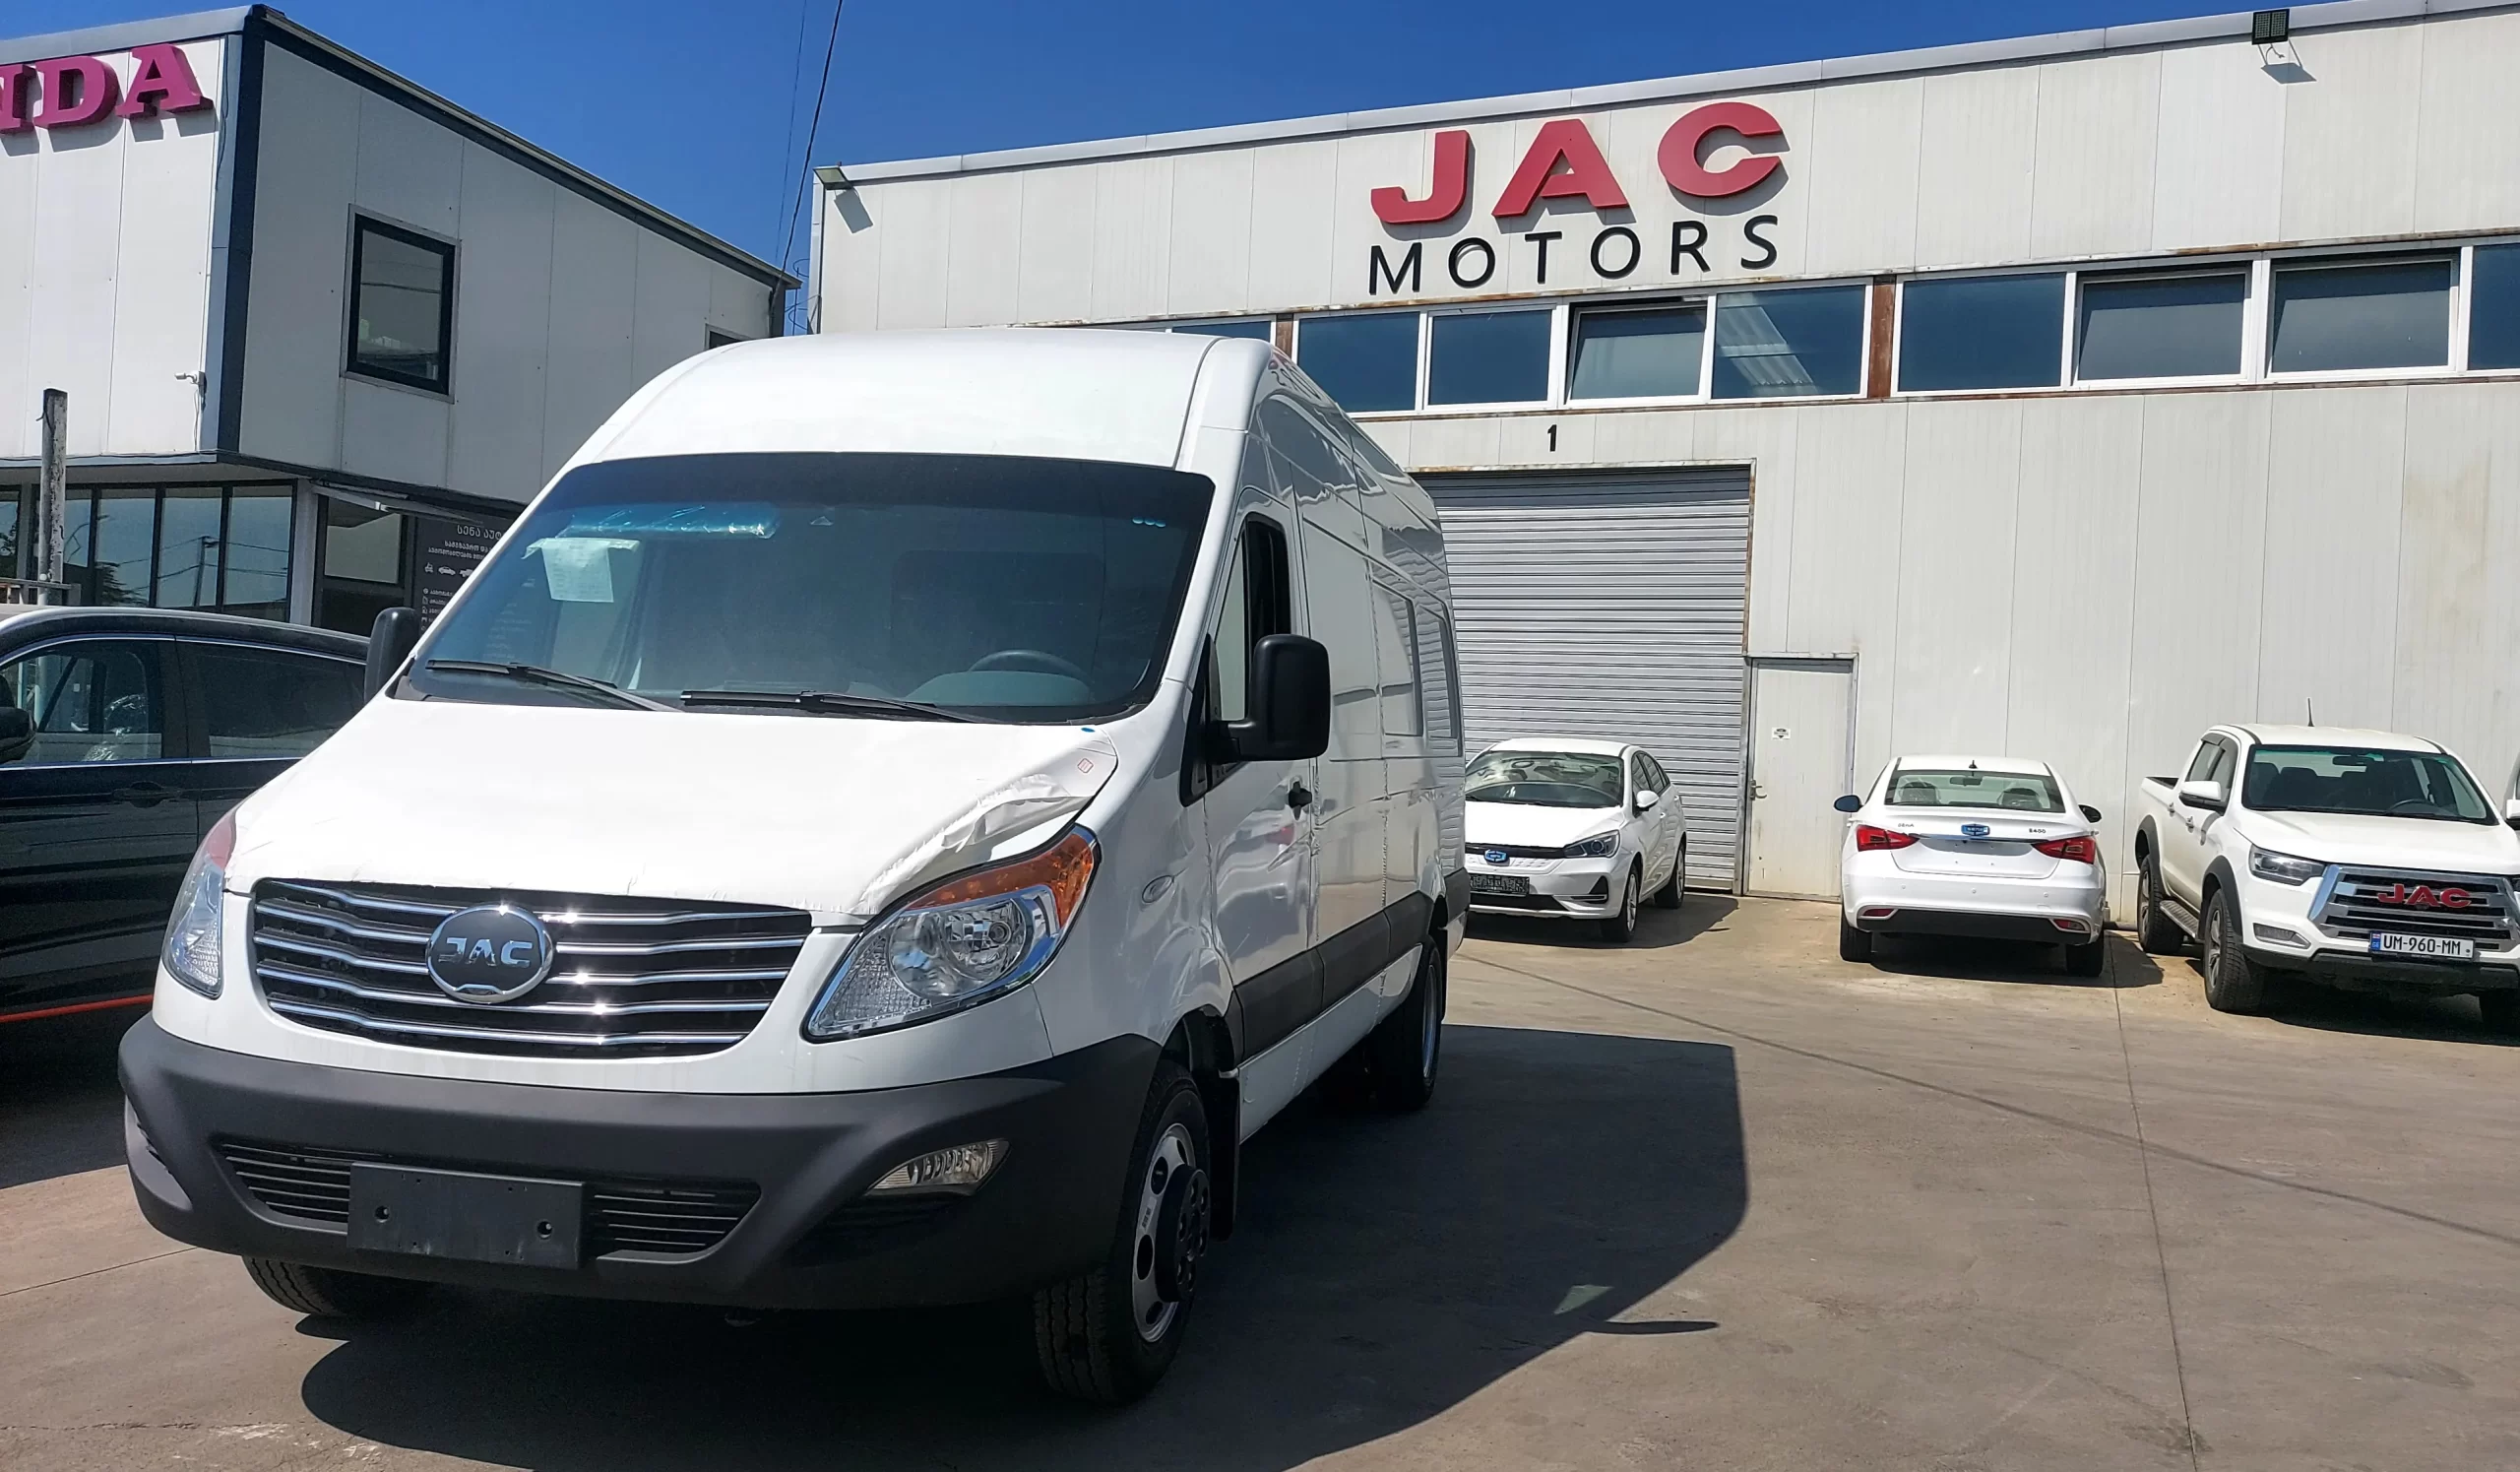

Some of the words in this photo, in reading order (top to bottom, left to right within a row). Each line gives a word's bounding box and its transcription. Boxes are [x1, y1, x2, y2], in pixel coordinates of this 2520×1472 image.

[1370, 101, 1785, 224] JAC
[1368, 214, 1779, 295] MOTORS
[1546, 423, 1557, 452] 1
[2377, 883, 2472, 908] JAC
[438, 937, 533, 969] JAC
[2383, 934, 2461, 956] UM-960-MM
